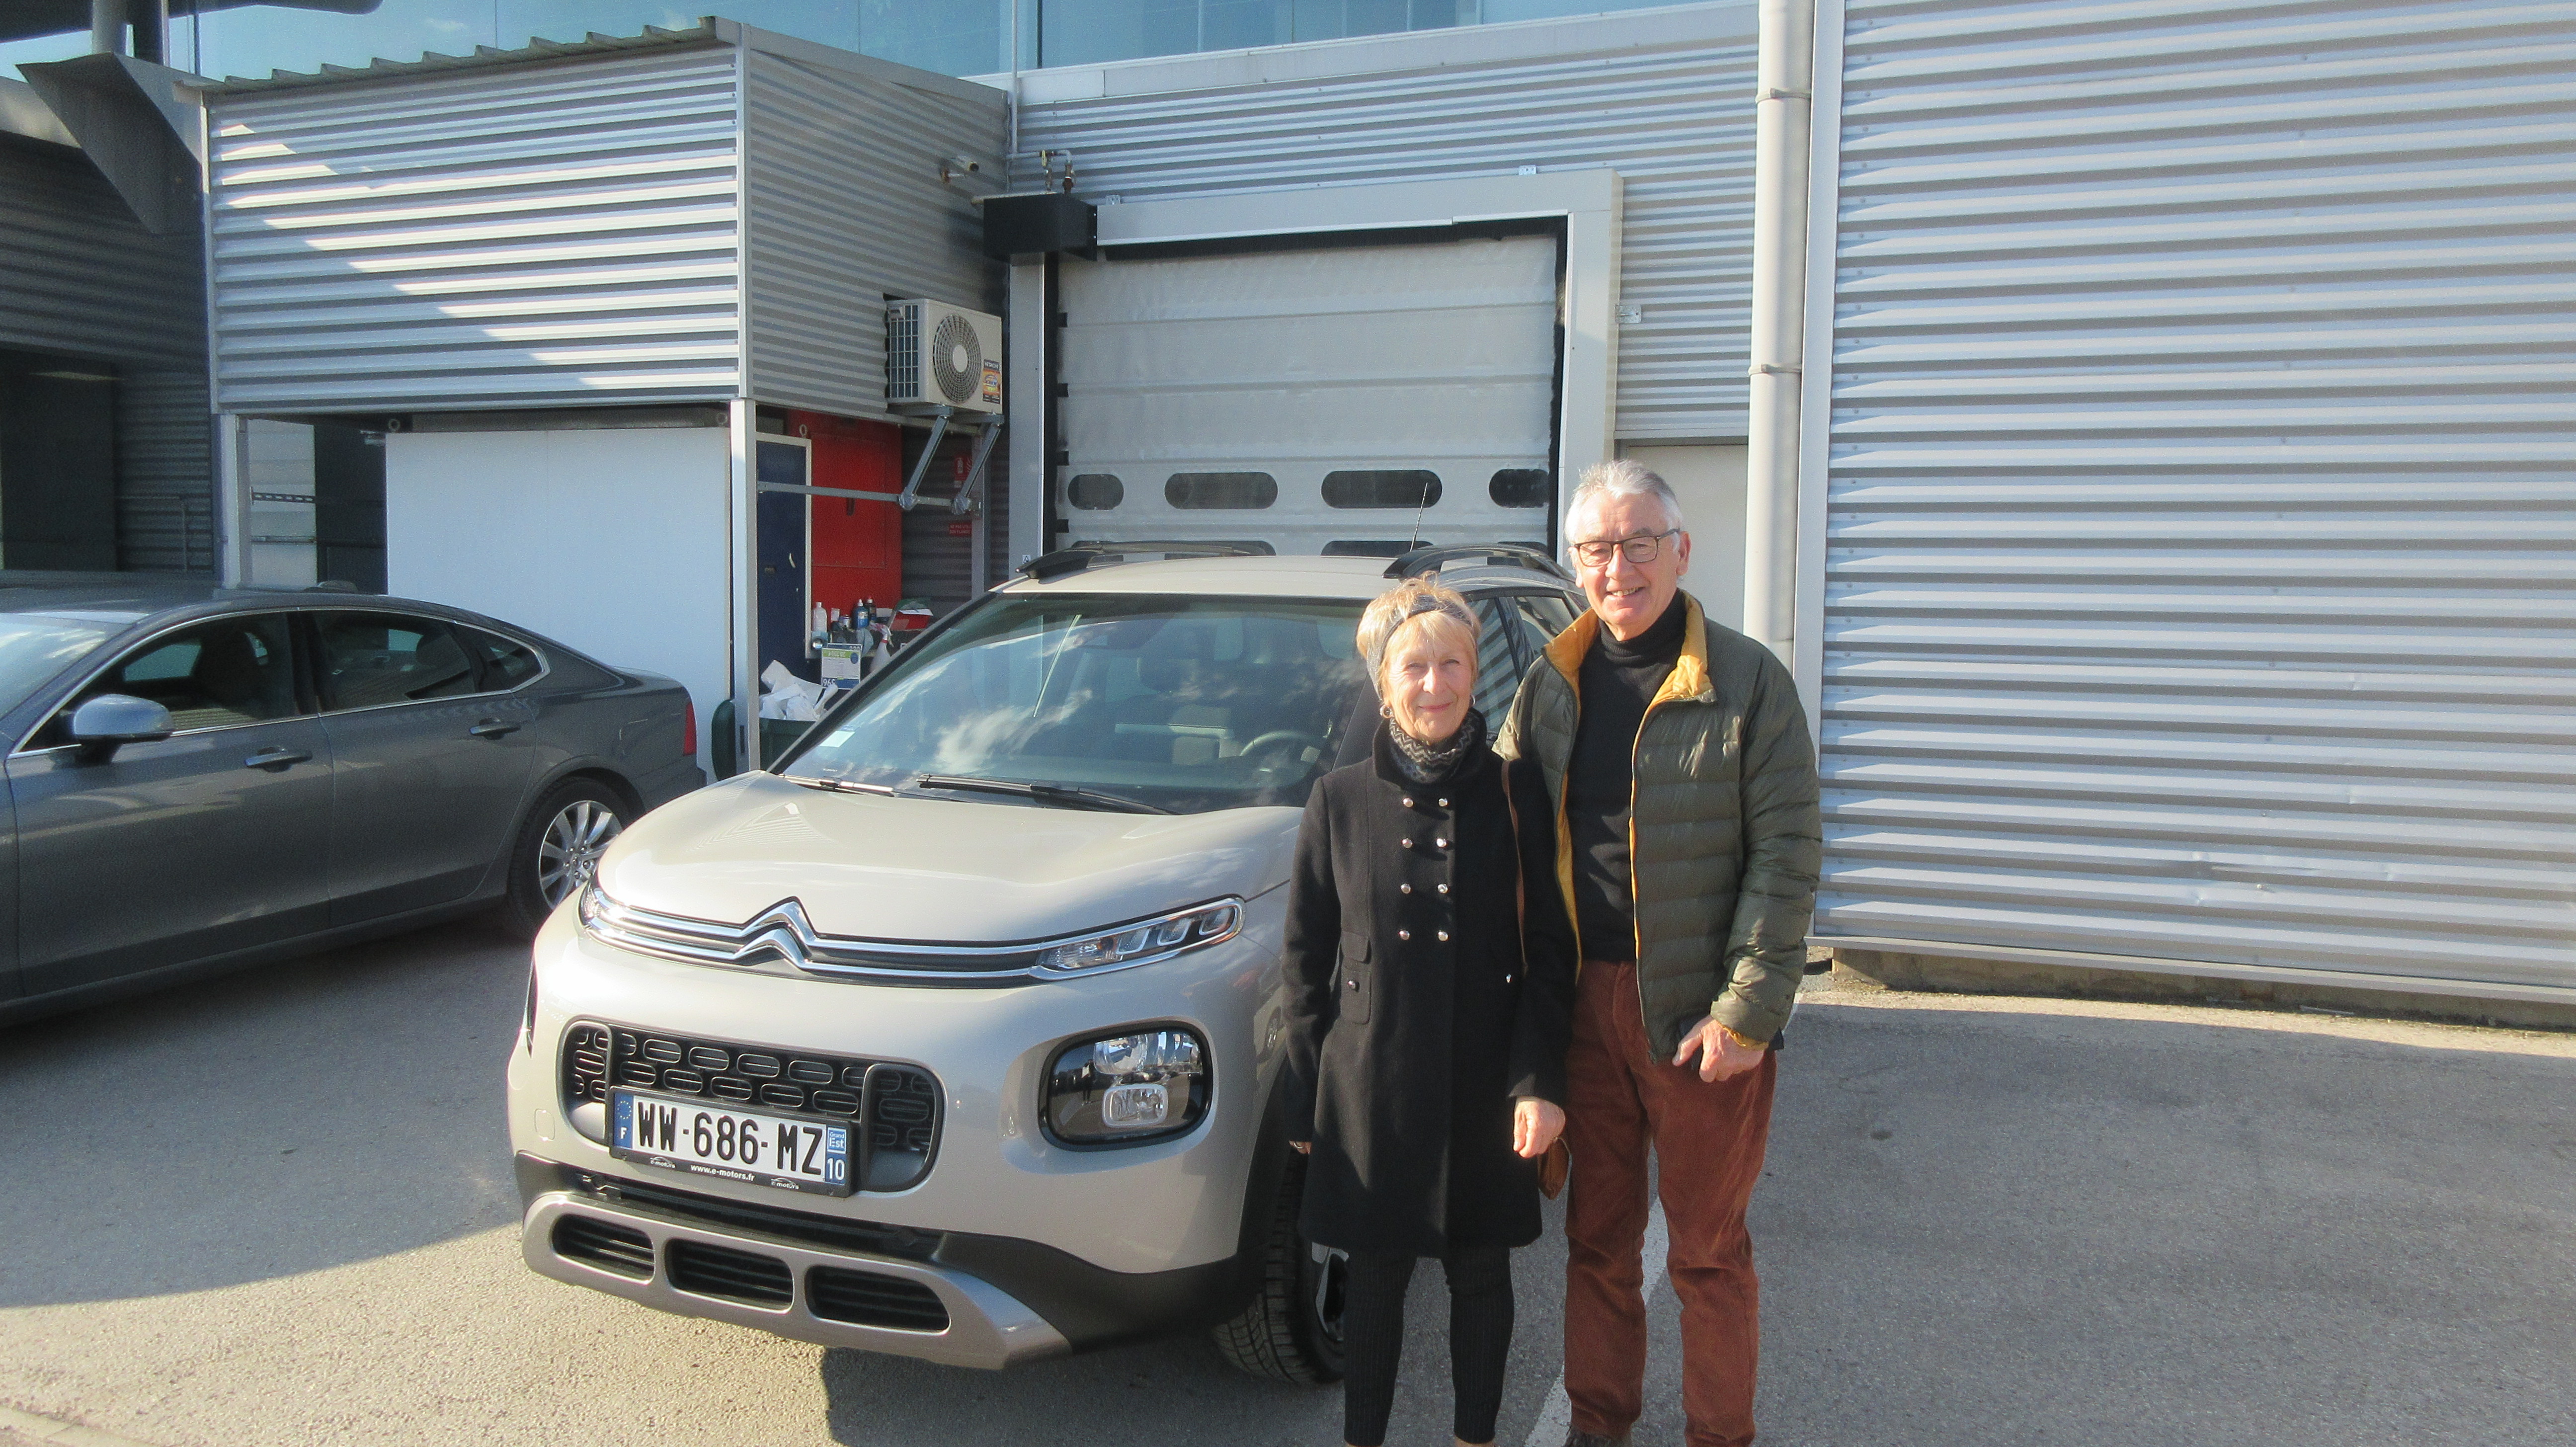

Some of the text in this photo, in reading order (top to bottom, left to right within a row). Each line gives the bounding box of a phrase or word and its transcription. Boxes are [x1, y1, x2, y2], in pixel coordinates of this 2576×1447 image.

[620, 1127, 627, 1139] F
[829, 1137, 844, 1148] Est
[691, 1164, 755, 1181] www.e-motors.fr
[827, 1158, 845, 1180] 10
